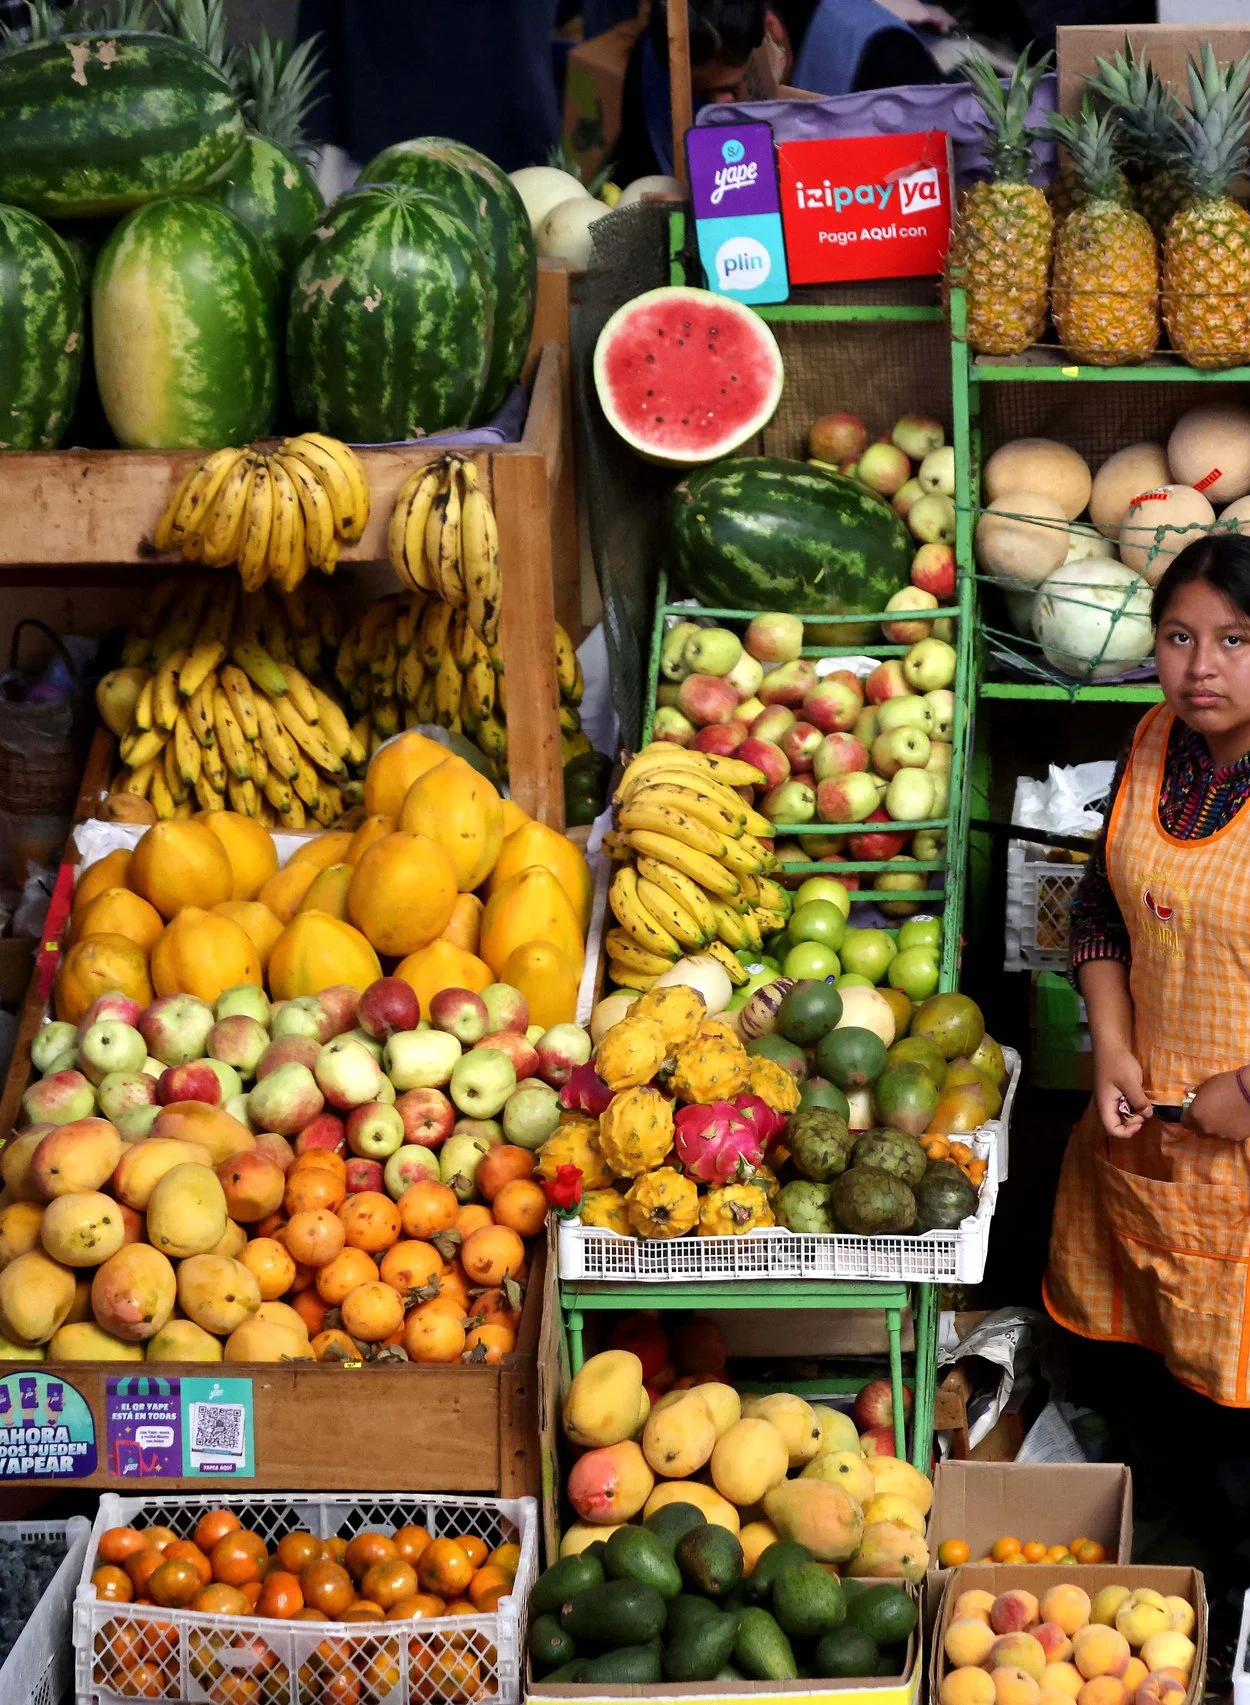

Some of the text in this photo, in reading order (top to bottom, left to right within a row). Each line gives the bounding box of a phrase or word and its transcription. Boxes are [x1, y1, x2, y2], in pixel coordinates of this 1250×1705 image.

[710, 161, 758, 204] yape
[796, 179, 938, 213] izipay ya
[818, 222, 928, 246] Paga AQUÍ con
[723, 252, 763, 277] plin
[112, 1411, 177, 1420] ESTÁ EN TODAS
[121, 1403, 169, 1411] EL QR YAPE
[0, 1426, 69, 1444] AHORA
[29, 1442, 88, 1456] PUEDEN
